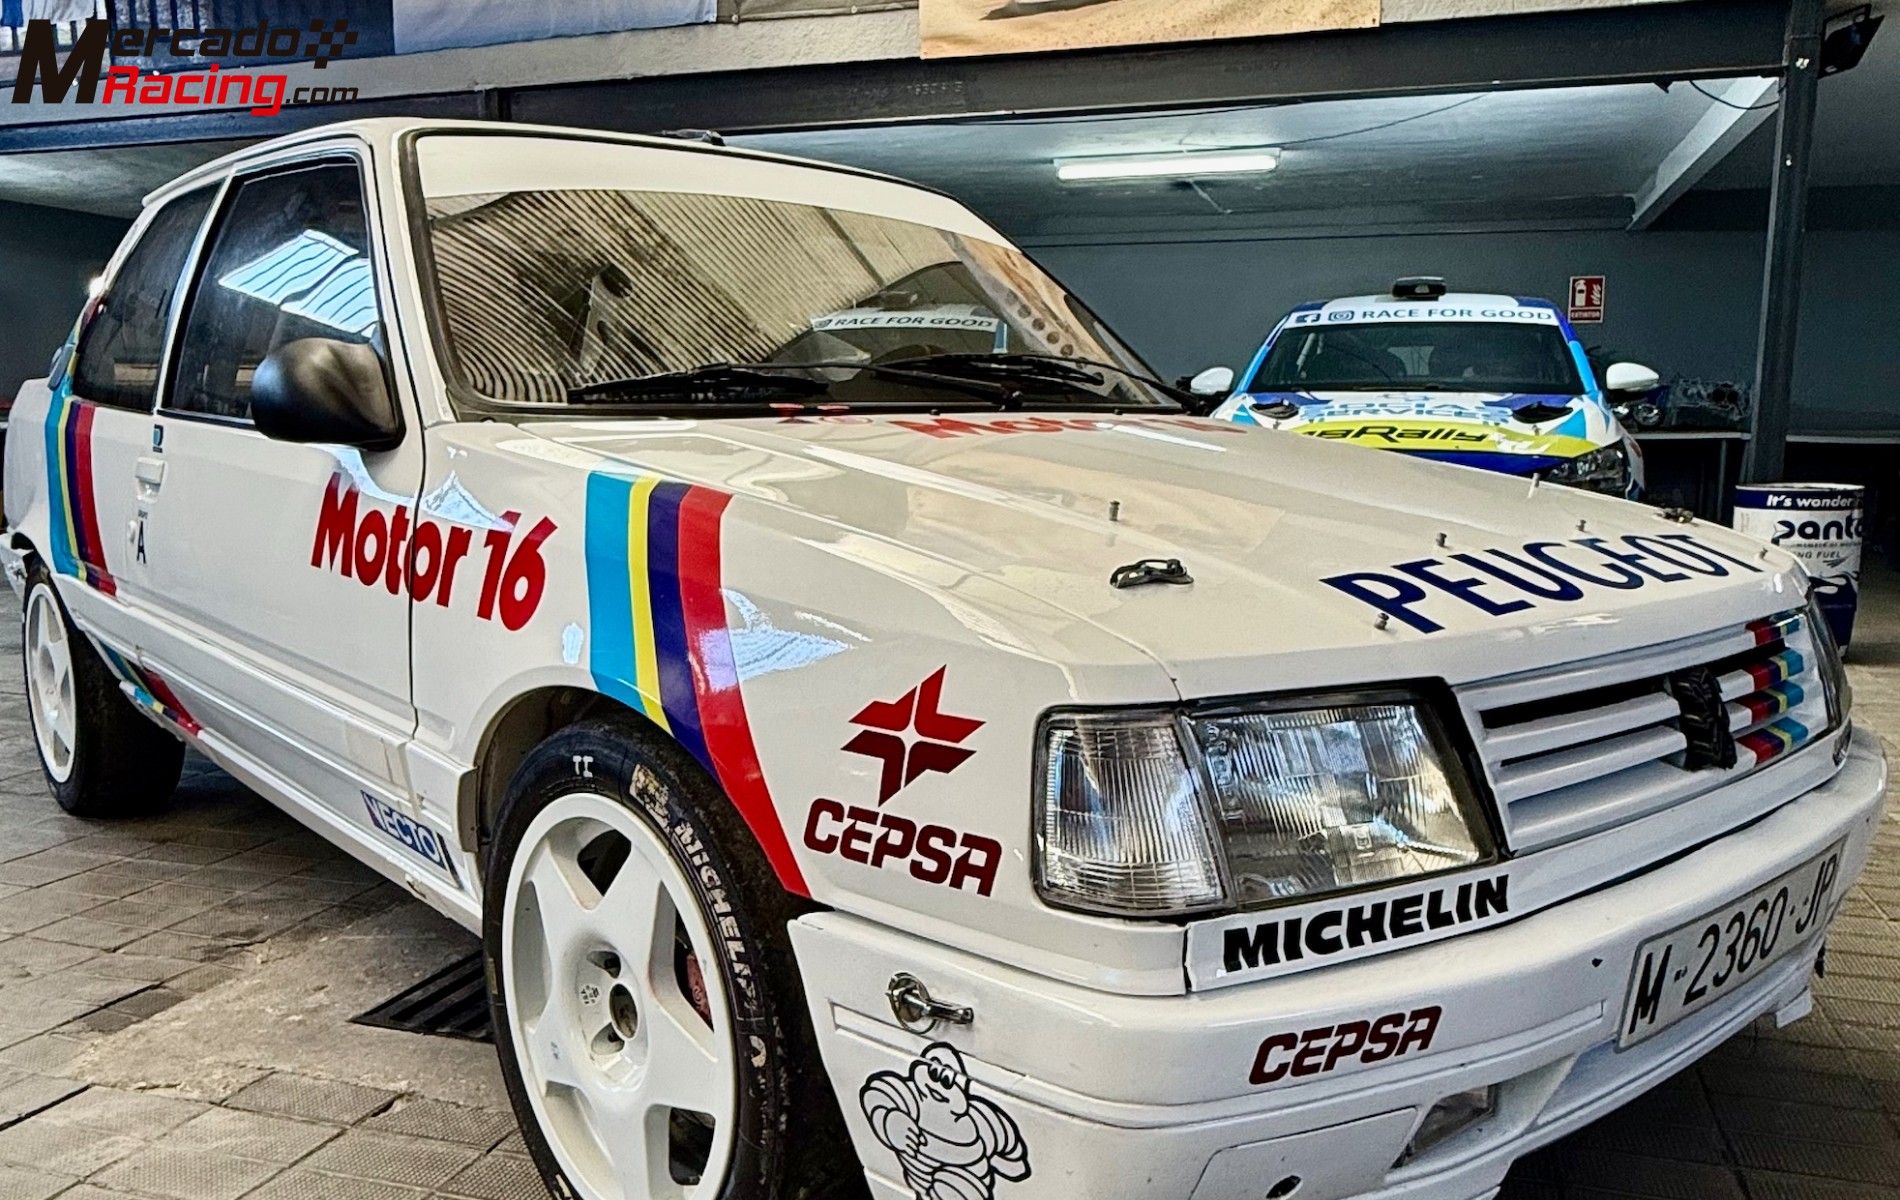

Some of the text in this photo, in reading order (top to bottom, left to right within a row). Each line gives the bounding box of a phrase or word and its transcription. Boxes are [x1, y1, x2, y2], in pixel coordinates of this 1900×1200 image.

[835, 316, 993, 328] RACE FOR GOOD
[1362, 309, 1552, 320] RACE FOR GOOD
[1766, 494, 1793, 507] It's
[136, 520, 147, 564] A
[311, 472, 558, 631] Motor 16
[1816, 551, 1841, 559] FUEL
[1319, 534, 1764, 634] PEUGEOT
[804, 798, 1002, 897] CEPSA
[1223, 874, 1510, 972] MICHELIN
[1249, 1006, 1442, 1085] CEPSA
